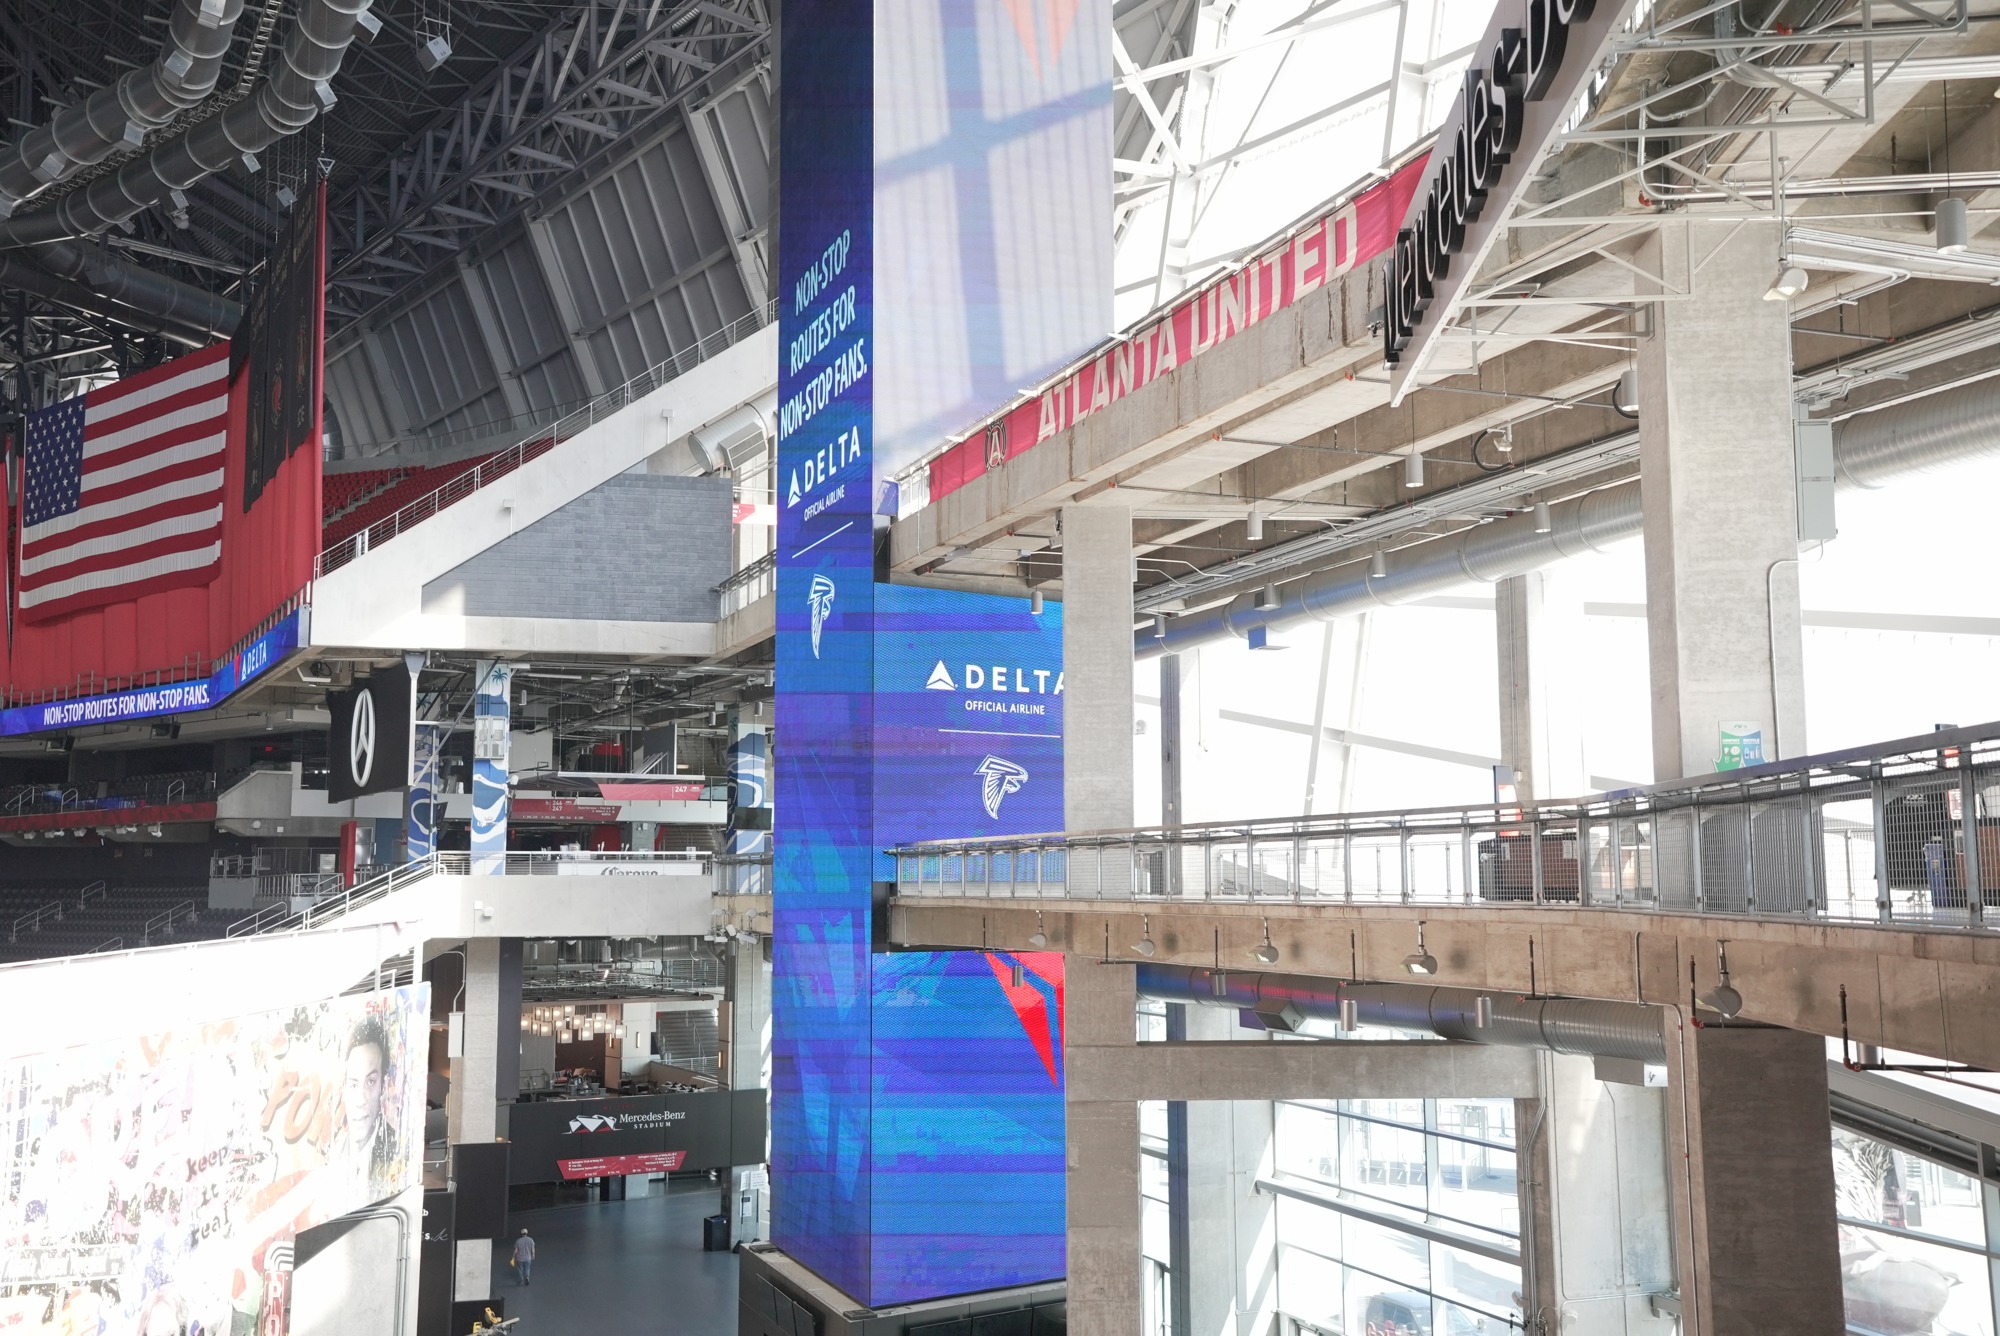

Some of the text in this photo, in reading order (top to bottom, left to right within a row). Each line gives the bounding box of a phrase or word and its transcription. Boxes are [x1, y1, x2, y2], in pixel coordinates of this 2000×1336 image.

[796, 228, 850, 317] NON-STOP
[790, 285, 856, 377] ROUTES FOR
[1036, 202, 1357, 445] ATLANTA UNITED
[780, 338, 868, 441] NON-STOP FANS.
[804, 425, 861, 493] DELTA
[803, 484, 845, 522] OFFICIAL AIRLINE
[247, 640, 267, 675] DELTA
[43, 684, 210, 726] NON-STOP ROUTES FOR NON-STOP FANS.
[965, 700, 1046, 715] OFFICIAL AIRLINE
[674, 785, 688, 793] 247
[619, 1110, 686, 1124] Mercedes-Benz
[633, 1121, 671, 1130] STADIUM
[185, 1145, 228, 1182] keep
